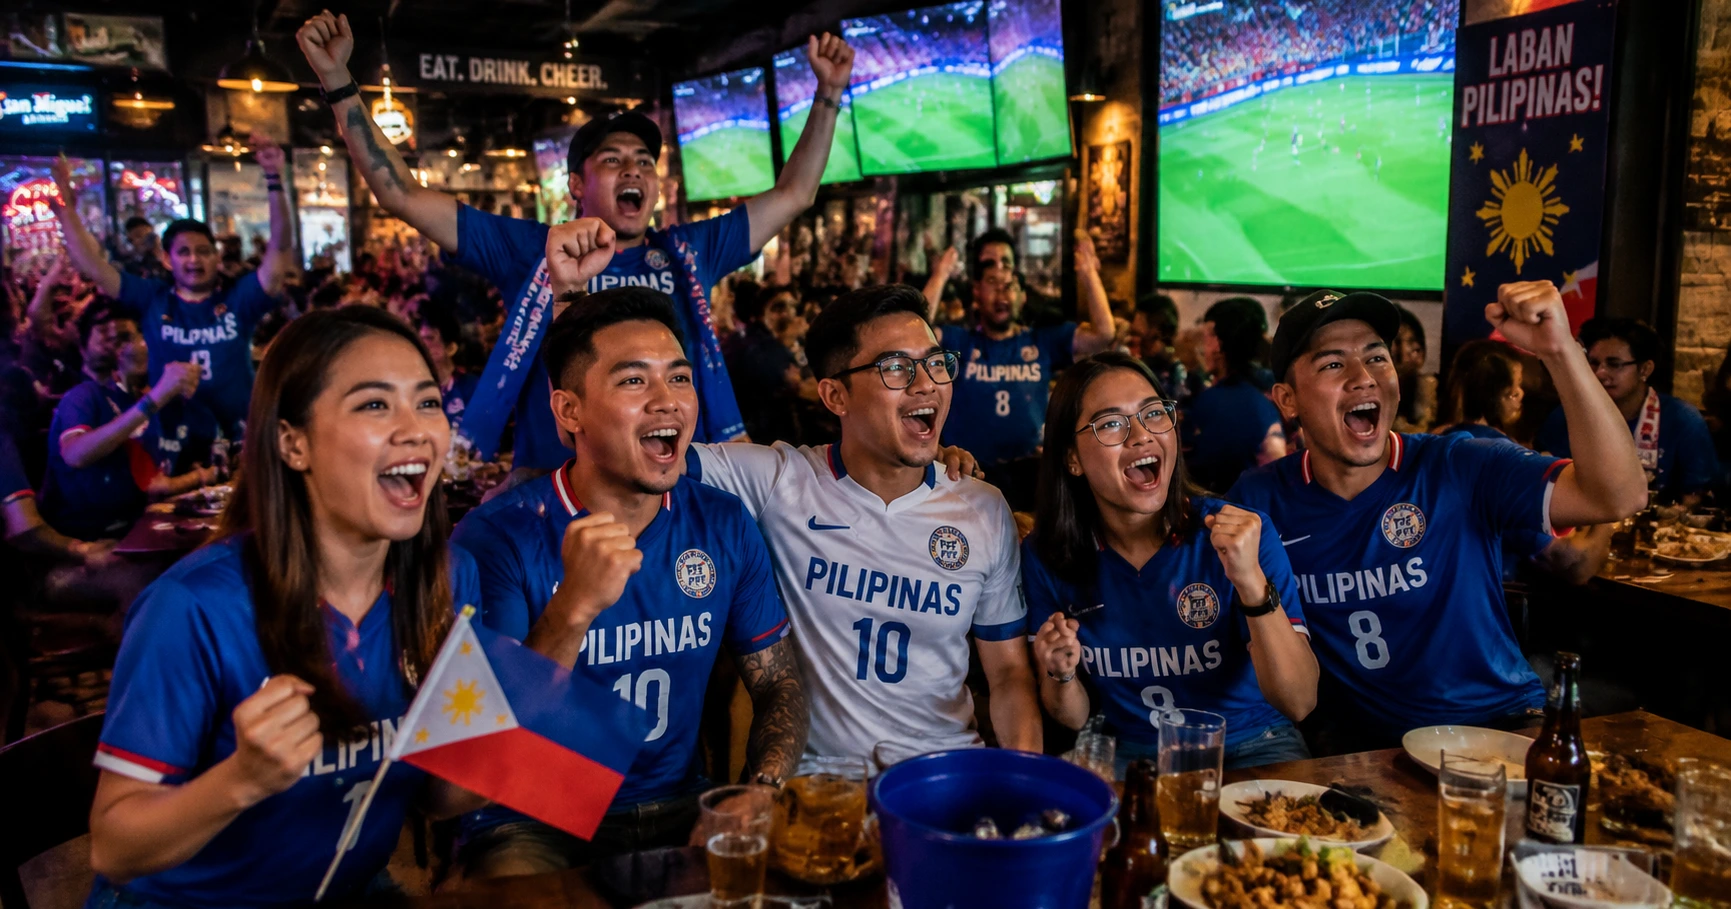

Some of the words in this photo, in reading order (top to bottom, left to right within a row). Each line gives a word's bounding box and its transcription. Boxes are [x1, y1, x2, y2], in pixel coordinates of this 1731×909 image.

[419, 53, 464, 81] EAT.
[469, 57, 538, 87] DRINK.
[540, 61, 608, 90] CHEER.
[1489, 22, 1575, 78] LABAN
[1460, 64, 1604, 128] PILIPINAS!
[965, 361, 1042, 382] PILIPINAS
[995, 390, 1011, 417] 8
[805, 556, 962, 616] PILIPINAS
[852, 617, 912, 684] 10
[1081, 639, 1222, 678] PILIPINAS
[1348, 610, 1391, 670] 8
